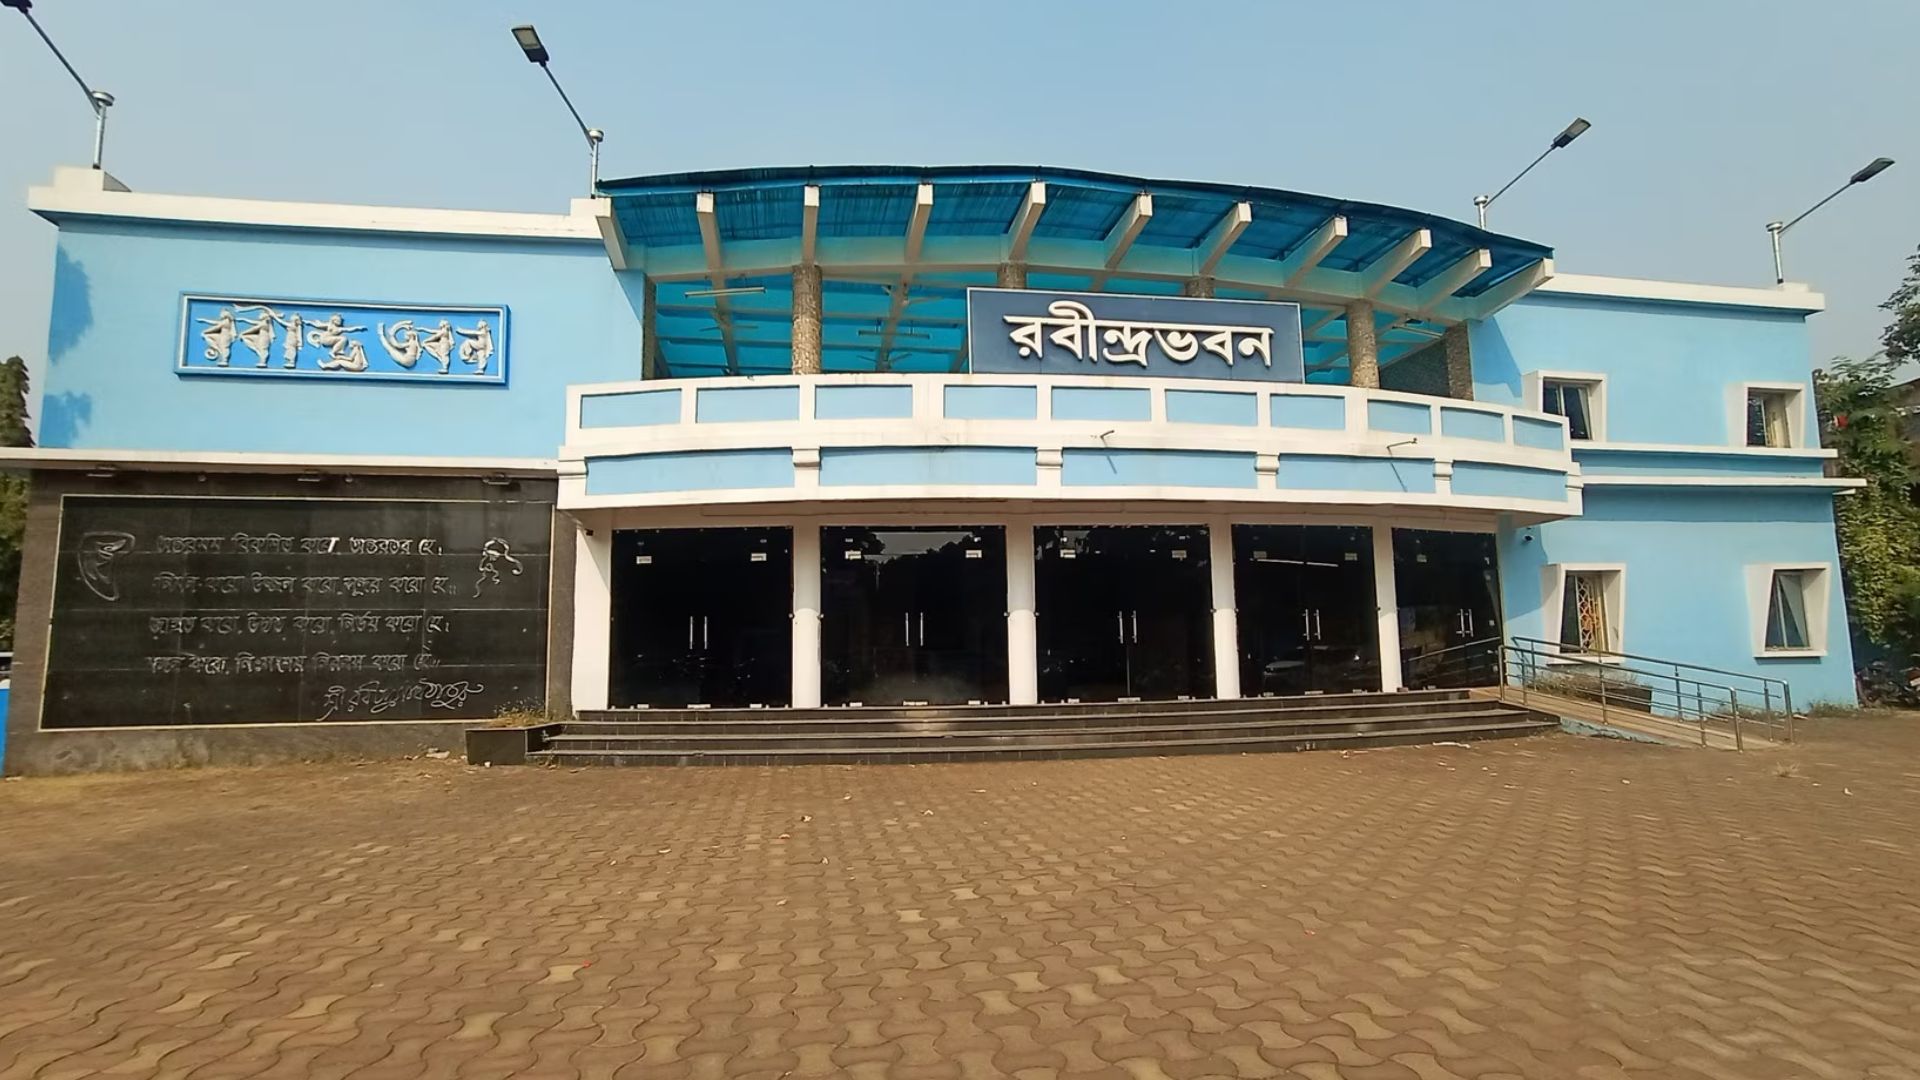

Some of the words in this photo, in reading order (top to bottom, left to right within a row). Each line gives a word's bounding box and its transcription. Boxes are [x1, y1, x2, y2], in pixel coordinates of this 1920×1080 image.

[1002, 300, 1274, 368] রবীন্দ্রভবন
[389, 577, 426, 594] করো
[384, 615, 422, 633] করো
[371, 654, 409, 672] করো
